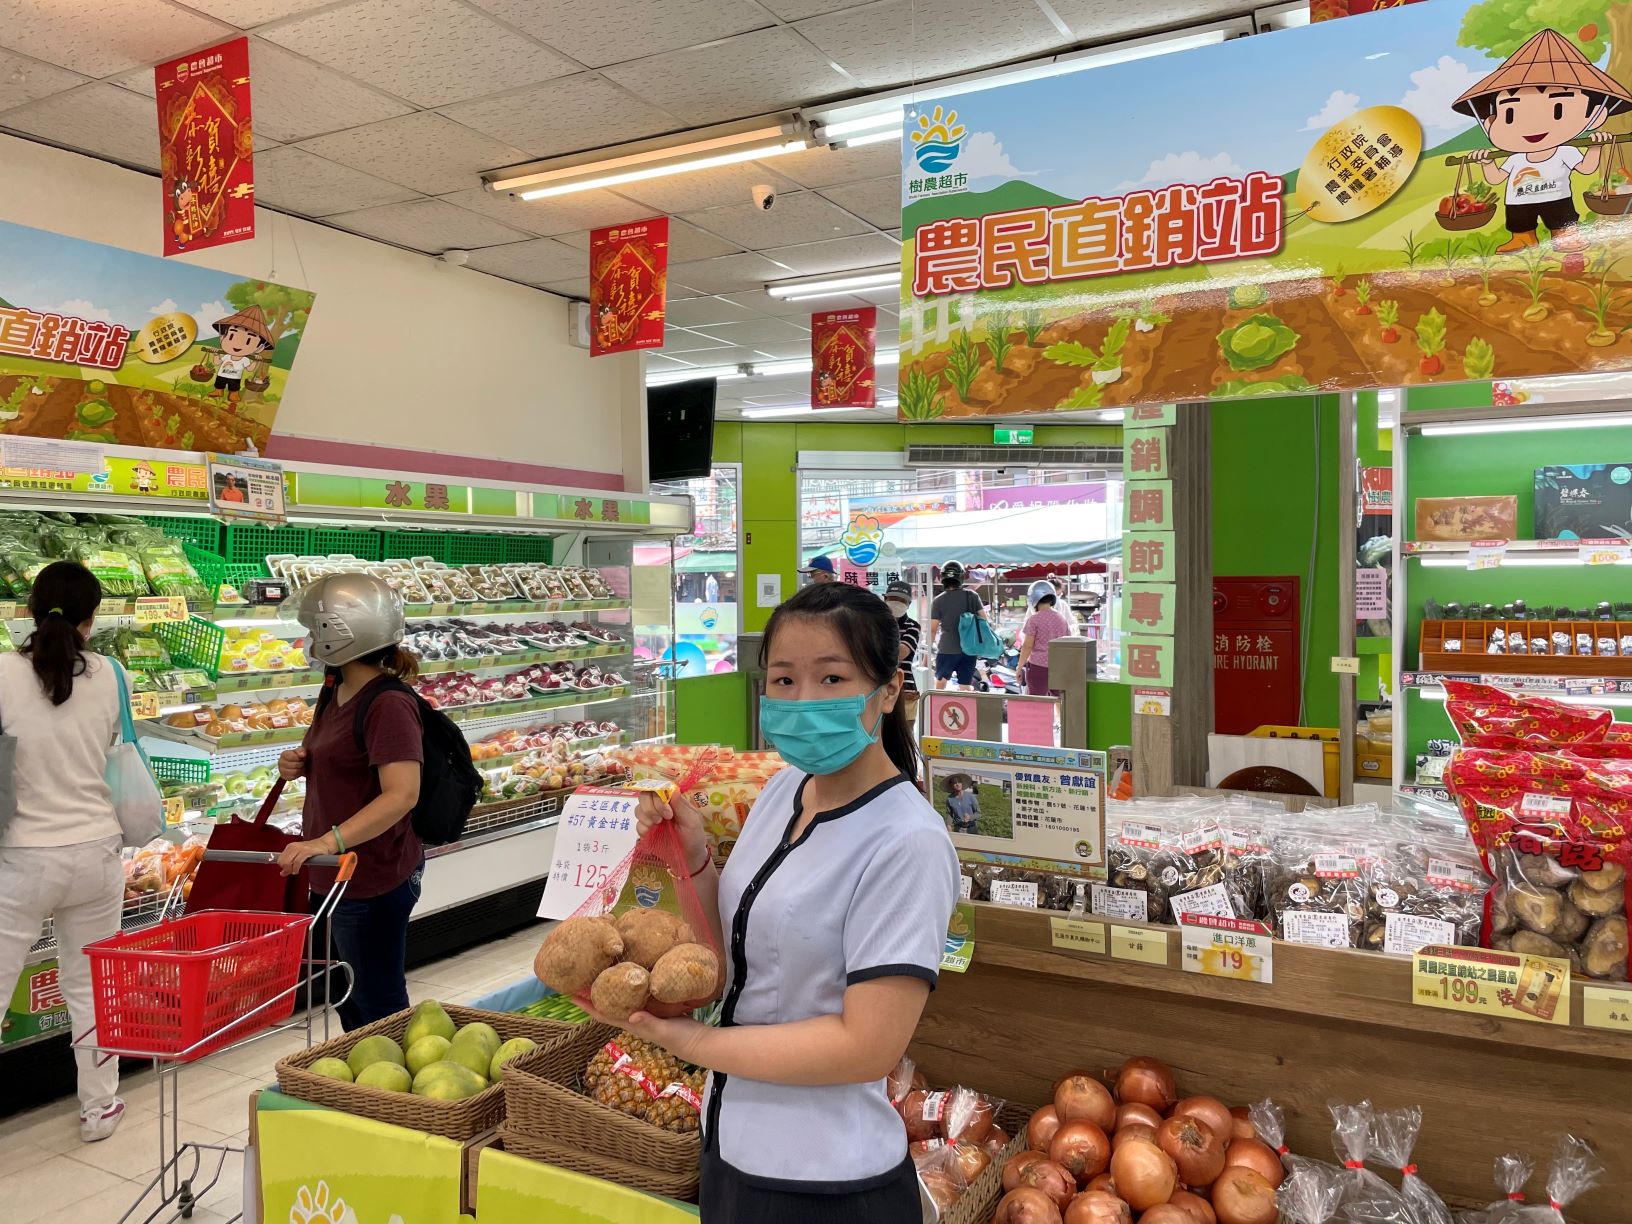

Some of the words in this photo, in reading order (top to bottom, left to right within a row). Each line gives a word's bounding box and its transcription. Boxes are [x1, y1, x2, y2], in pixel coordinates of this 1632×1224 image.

[190, 53, 223, 72] 農會超市
[1324, 132, 1394, 195] 農業委員會
[1326, 132, 1369, 172] 行政院
[909, 172, 968, 194] 樹農超市
[1335, 144, 1404, 206] 農糧署輔導
[913, 170, 1285, 297] 農民直銷站
[385, 480, 450, 511] 水果
[574, 497, 620, 522] 水果
[1215, 633, 1273, 653] 消防栓
[1213, 655, 1230, 670] IRE
[1233, 655, 1279, 671] HYDRANT
[577, 800, 632, 814] 三芝區農會
[567, 814, 586, 827] #57
[573, 863, 609, 889] 125
[1212, 933, 1257, 948] 進口洋蔥
[1219, 950, 1244, 970] 19
[29, 968, 67, 1014] 農
[1439, 976, 1479, 1004] 199
[1478, 996, 1488, 1005] 元
[1496, 987, 1517, 1008] 送
[38, 1010, 73, 1031] 行政
